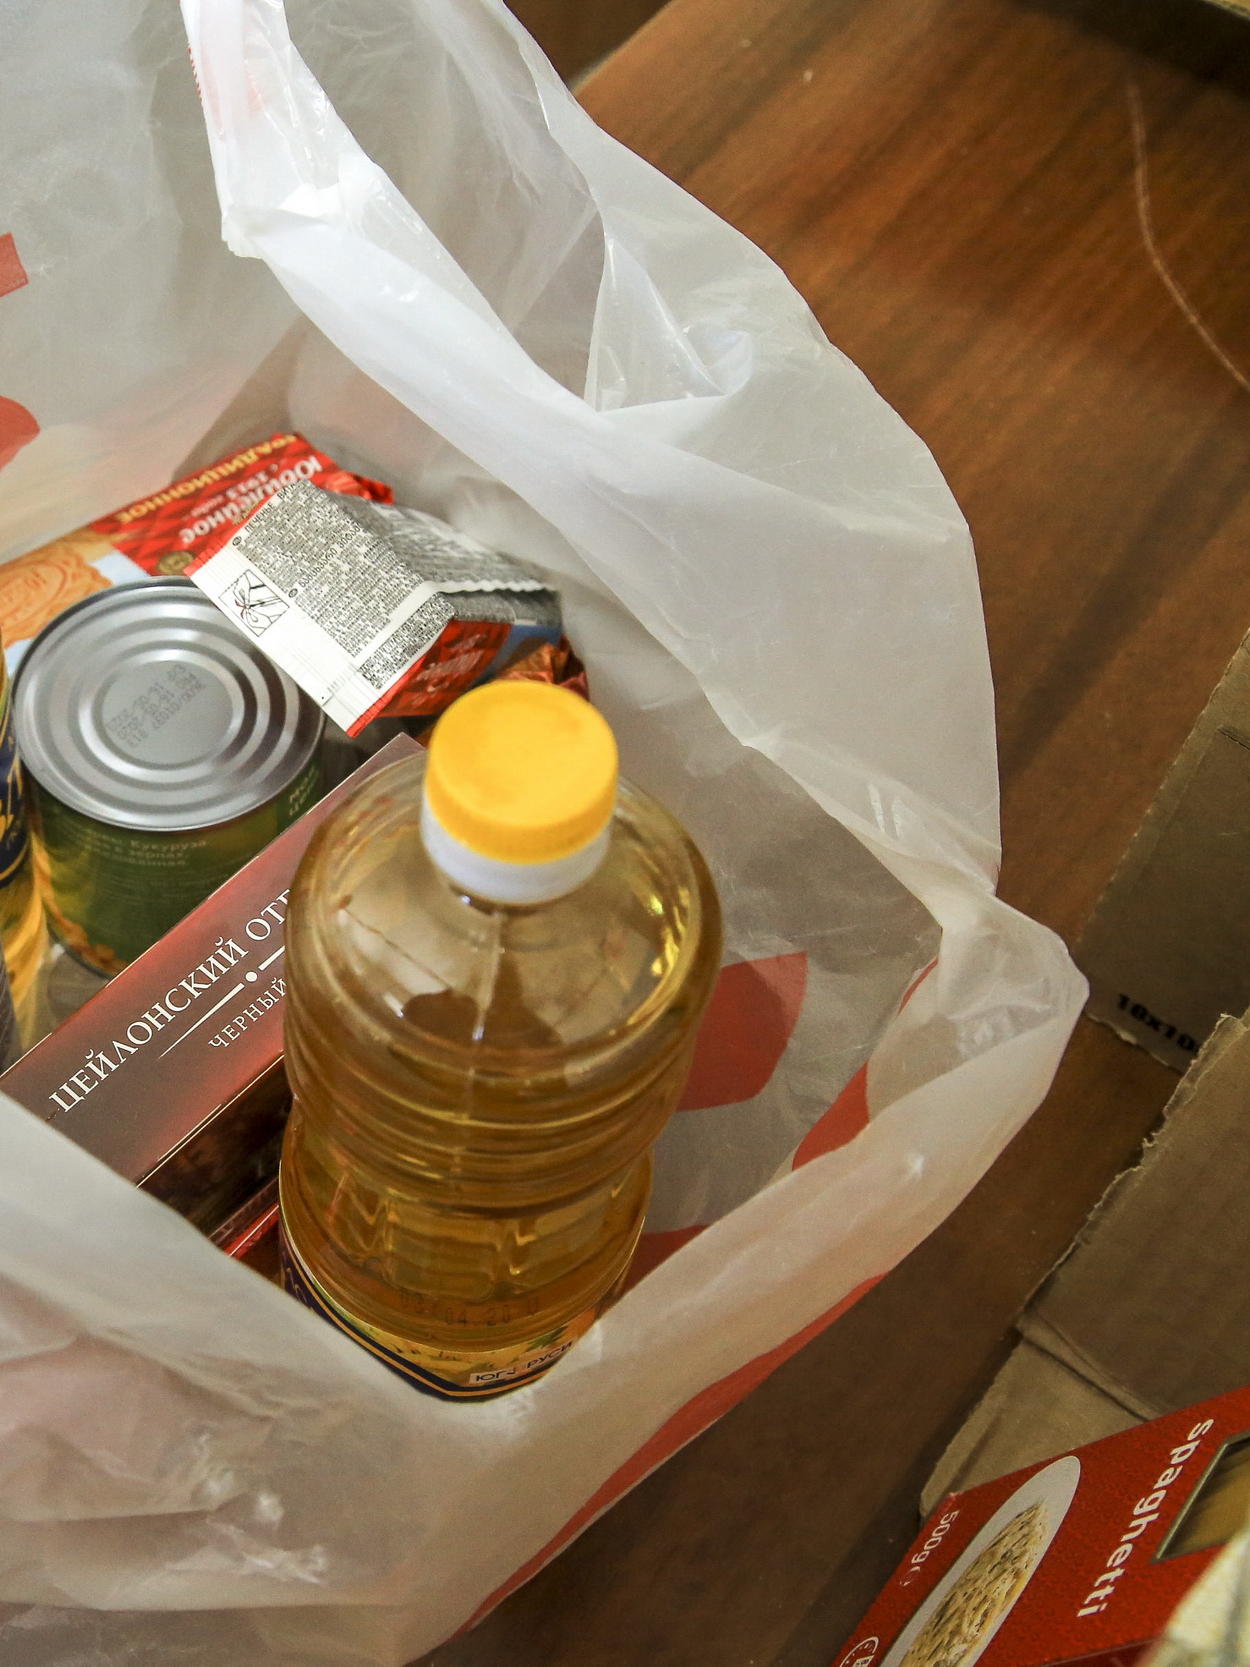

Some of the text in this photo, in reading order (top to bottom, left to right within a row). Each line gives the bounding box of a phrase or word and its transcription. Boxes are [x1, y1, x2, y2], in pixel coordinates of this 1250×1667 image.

[48, 936, 249, 1112] ЦЕЙЛОНСКИЙ
[208, 977, 286, 1048] ЧЕРНЫЙ
[1077, 1418, 1215, 1617] spaghetti
